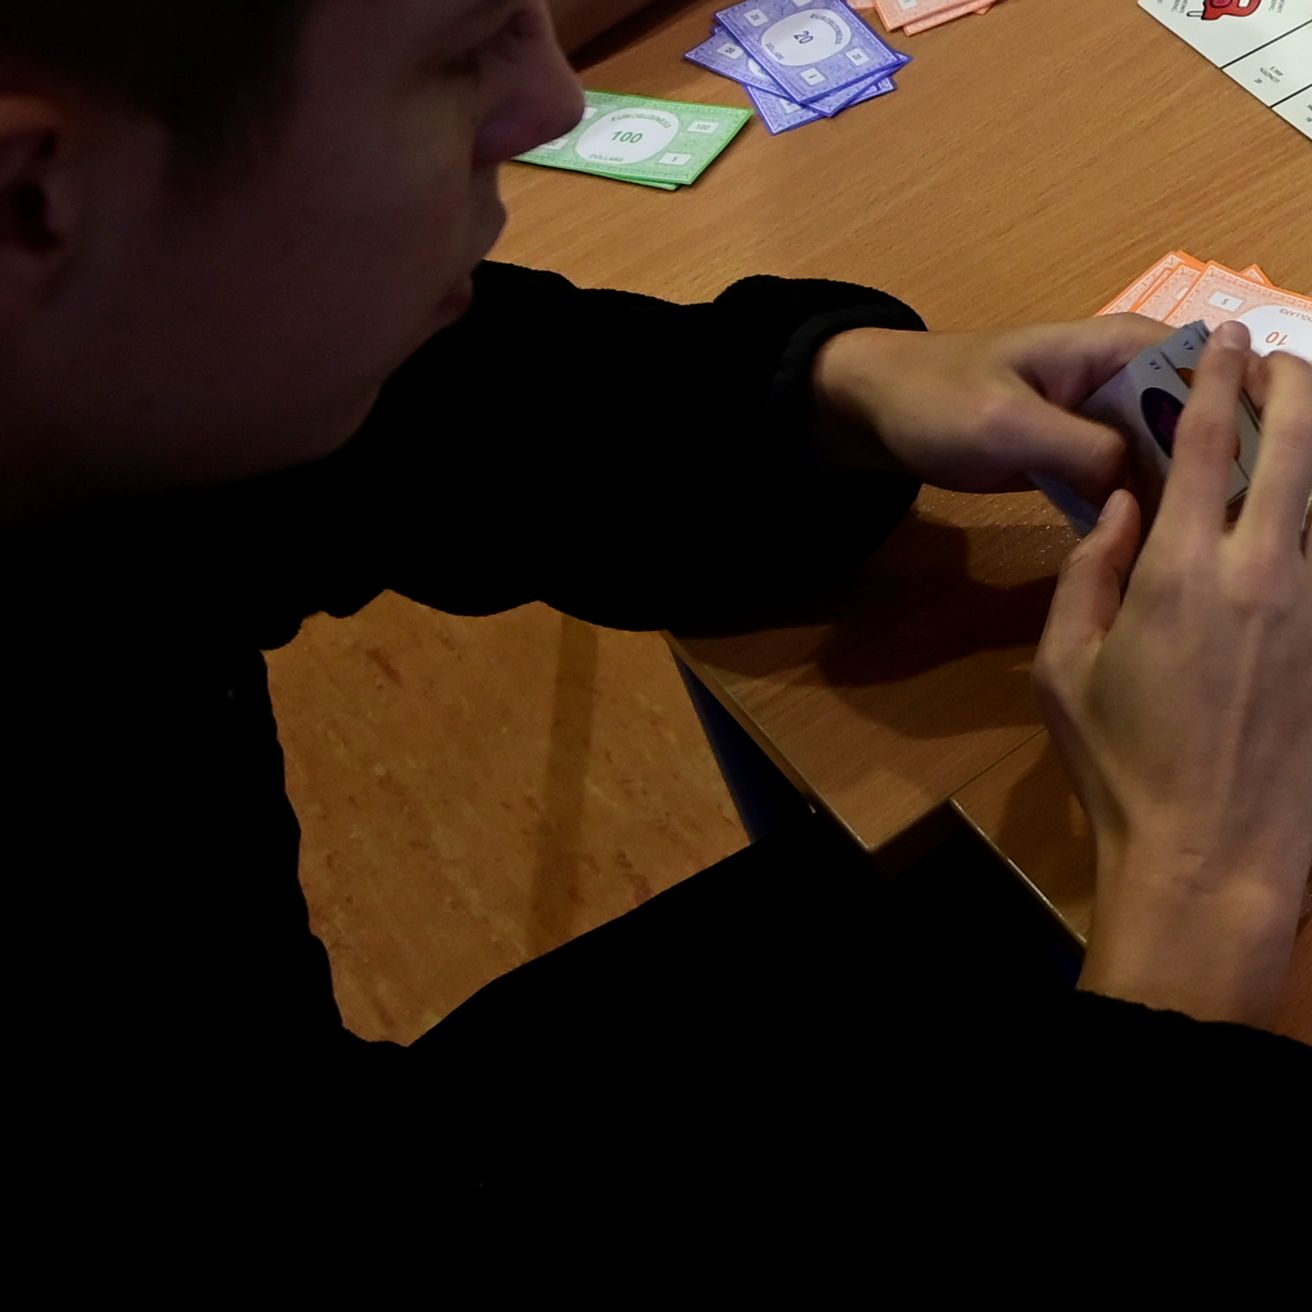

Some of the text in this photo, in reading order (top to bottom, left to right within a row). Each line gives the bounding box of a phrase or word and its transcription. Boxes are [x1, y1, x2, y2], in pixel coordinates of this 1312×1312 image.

[793, 30, 814, 45] 20
[610, 129, 644, 145] 100
[1264, 329, 1290, 347] 10
